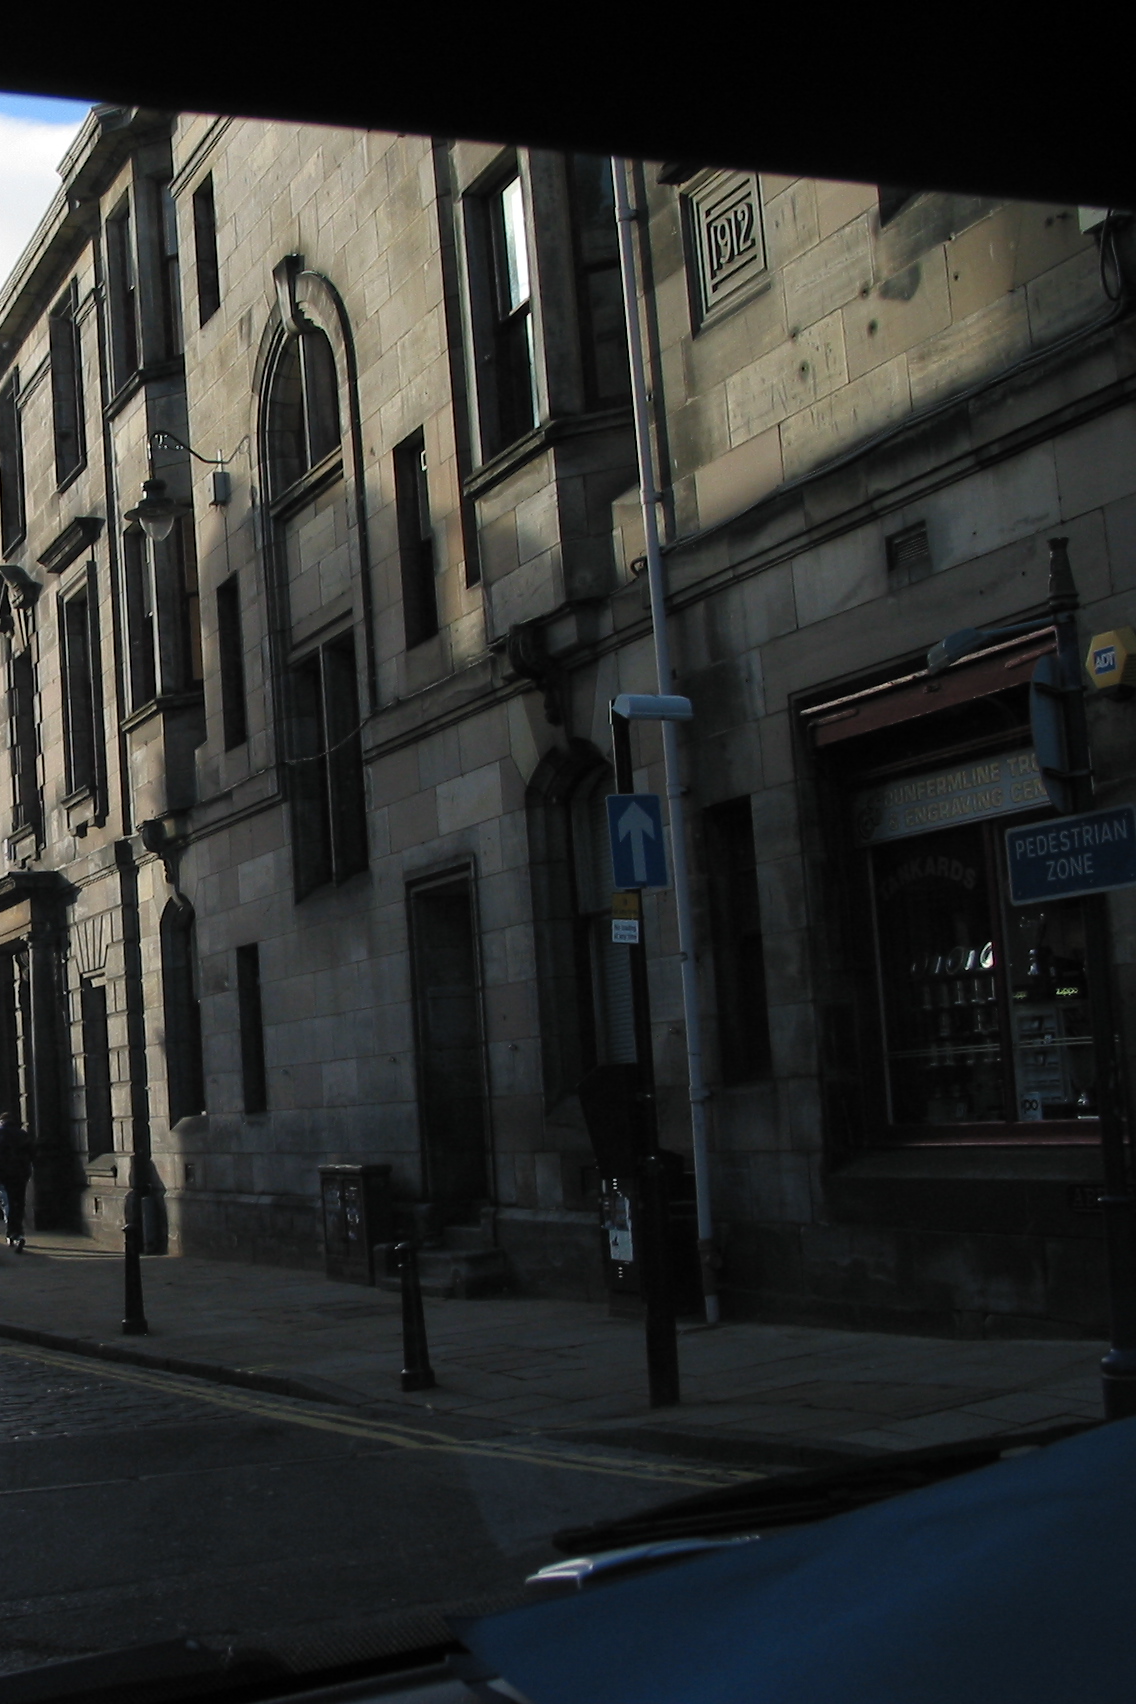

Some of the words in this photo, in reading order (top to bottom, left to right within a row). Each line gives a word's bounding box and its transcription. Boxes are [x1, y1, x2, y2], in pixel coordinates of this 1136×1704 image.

[710, 203, 753, 271] 1912
[1095, 651, 1115, 669] ADT
[883, 763, 1001, 808] DUNFERMLINE
[904, 787, 1004, 828] ENGRAVING
[1015, 819, 1128, 860] PEDESTRIAN
[878, 855, 977, 901] TANKARDS
[1046, 853, 1094, 881] ZONE
